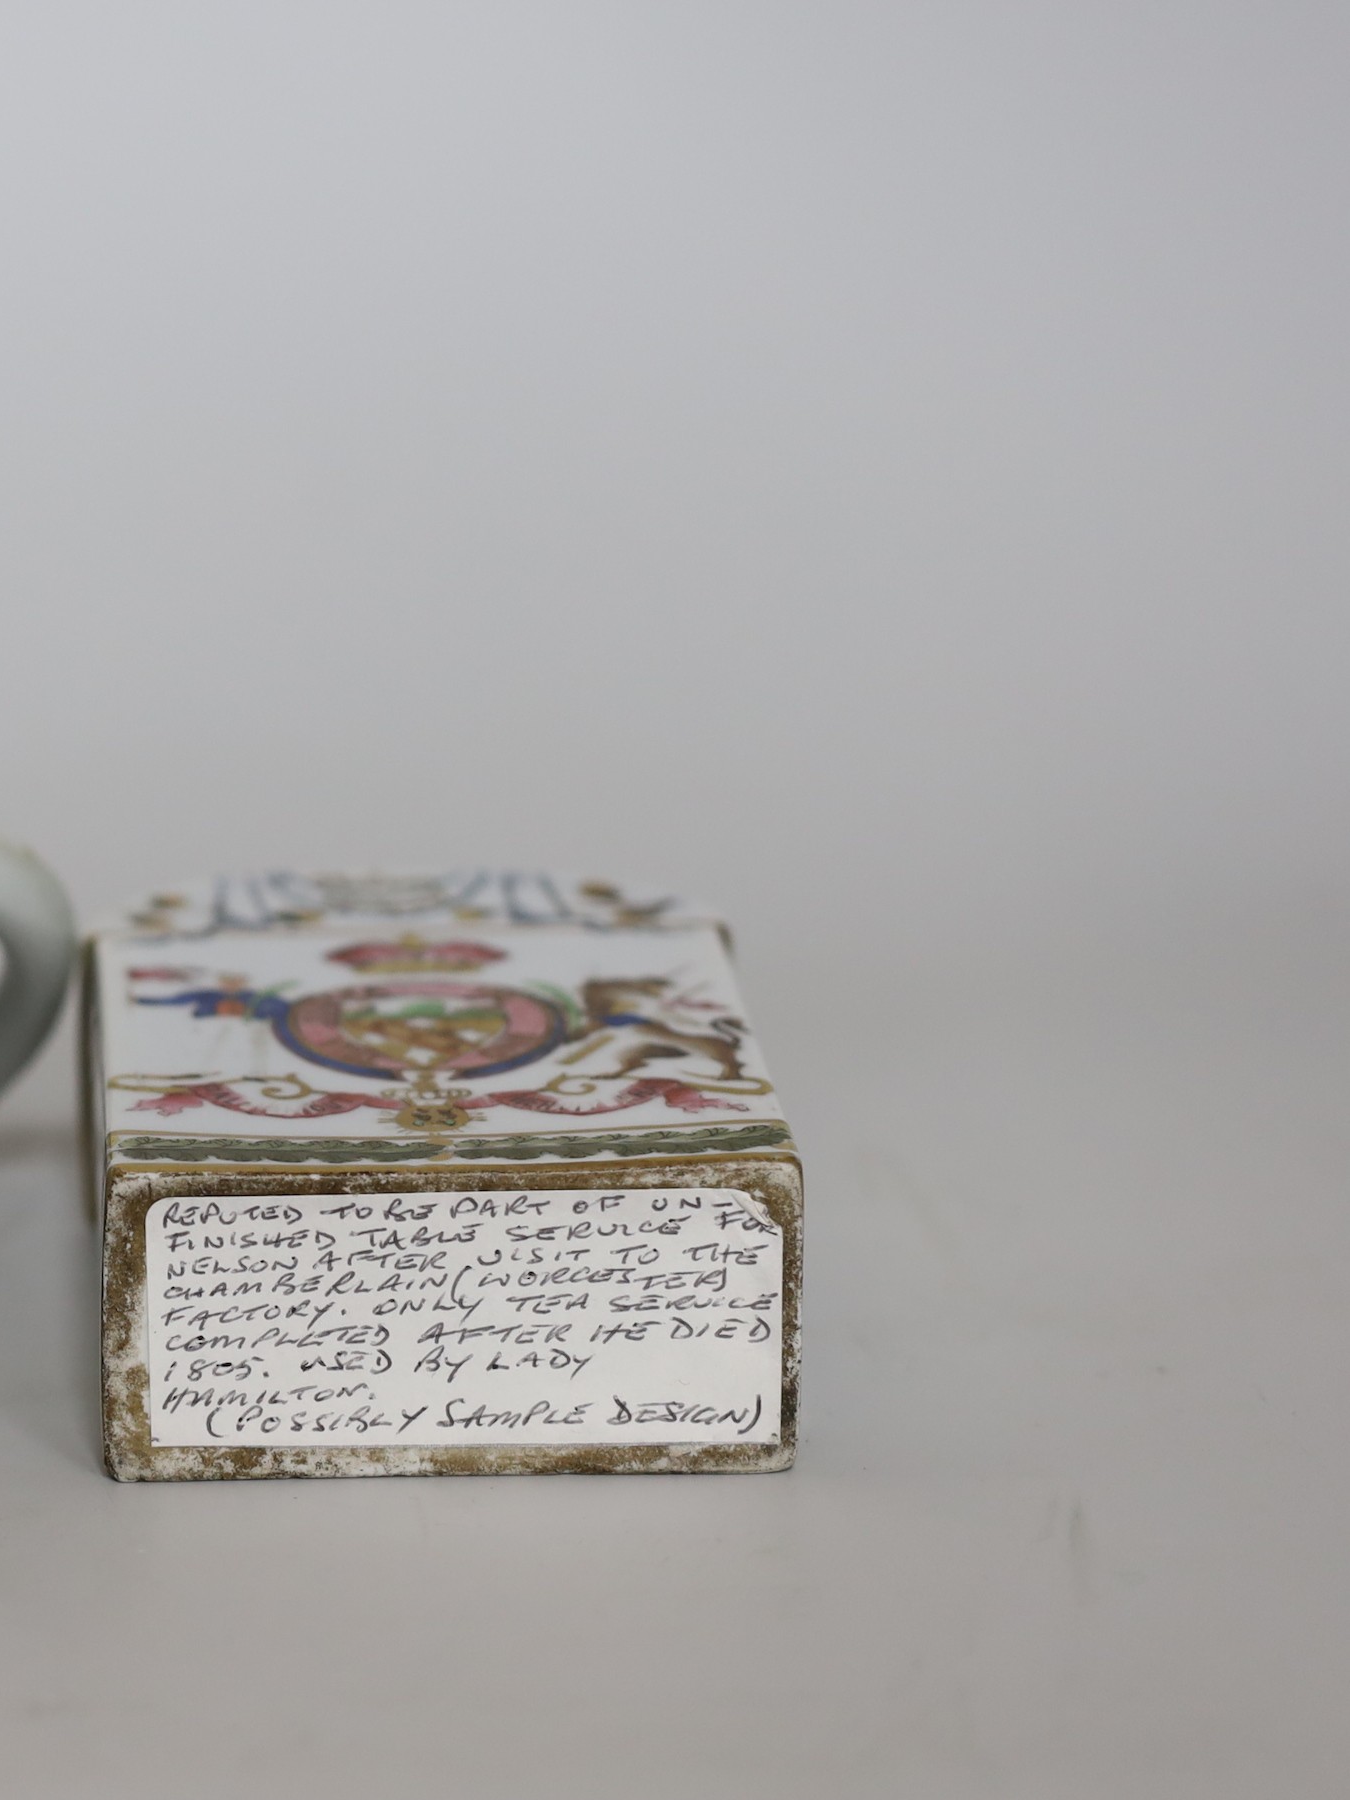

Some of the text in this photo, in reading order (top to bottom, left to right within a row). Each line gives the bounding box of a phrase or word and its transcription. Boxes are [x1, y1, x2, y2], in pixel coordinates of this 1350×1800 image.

[320, 1203, 373, 1220] TO
[383, 1198, 438, 1220] BE
[451, 1195, 550, 1217] PART
[573, 1195, 625, 1214] OF
[165, 1231, 336, 1252] FINISHED
[350, 1222, 484, 1250] TABLE
[506, 1216, 692, 1241] SERVICE
[167, 1256, 298, 1279] NELSON
[313, 1250, 448, 1270] AFTER
[610, 1244, 660, 1264] TO
[683, 1243, 769, 1266] THE
[161, 1292, 778, 1330] FACTORY. ONLY TEA SERVICE
[166, 1315, 771, 1353] COMPLETED AFTER HE DIED
[301, 1350, 392, 1375] USED
[414, 1345, 472, 1383] BY
[486, 1348, 594, 1380] LADY
[207, 1394, 761, 1438] (POSSIBLY SAMPLE DESIGN)
